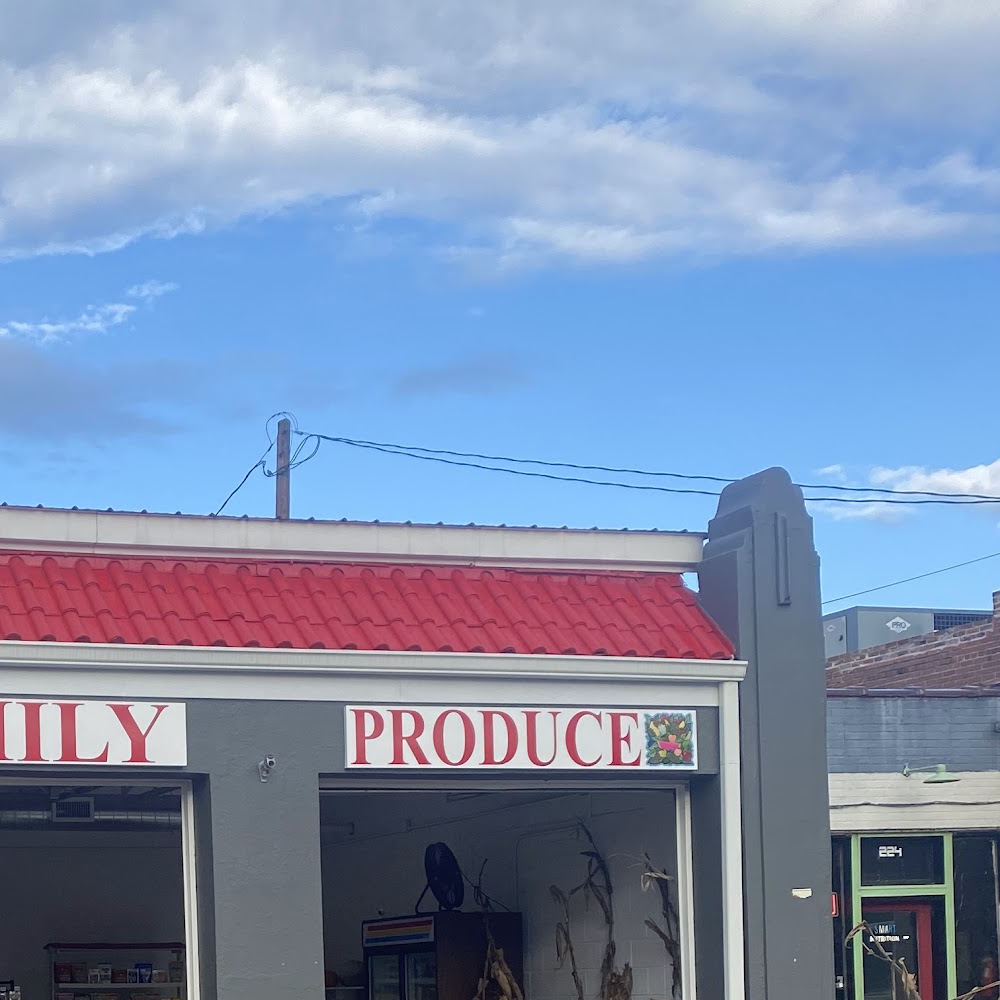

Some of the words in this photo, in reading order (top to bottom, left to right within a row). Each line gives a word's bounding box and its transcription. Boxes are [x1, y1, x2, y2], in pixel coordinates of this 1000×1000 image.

[892, 621, 906, 629] PRO
[350, 709, 642, 768] PRODUCE
[879, 846, 902, 857] 224
[874, 924, 896, 934] SMART
